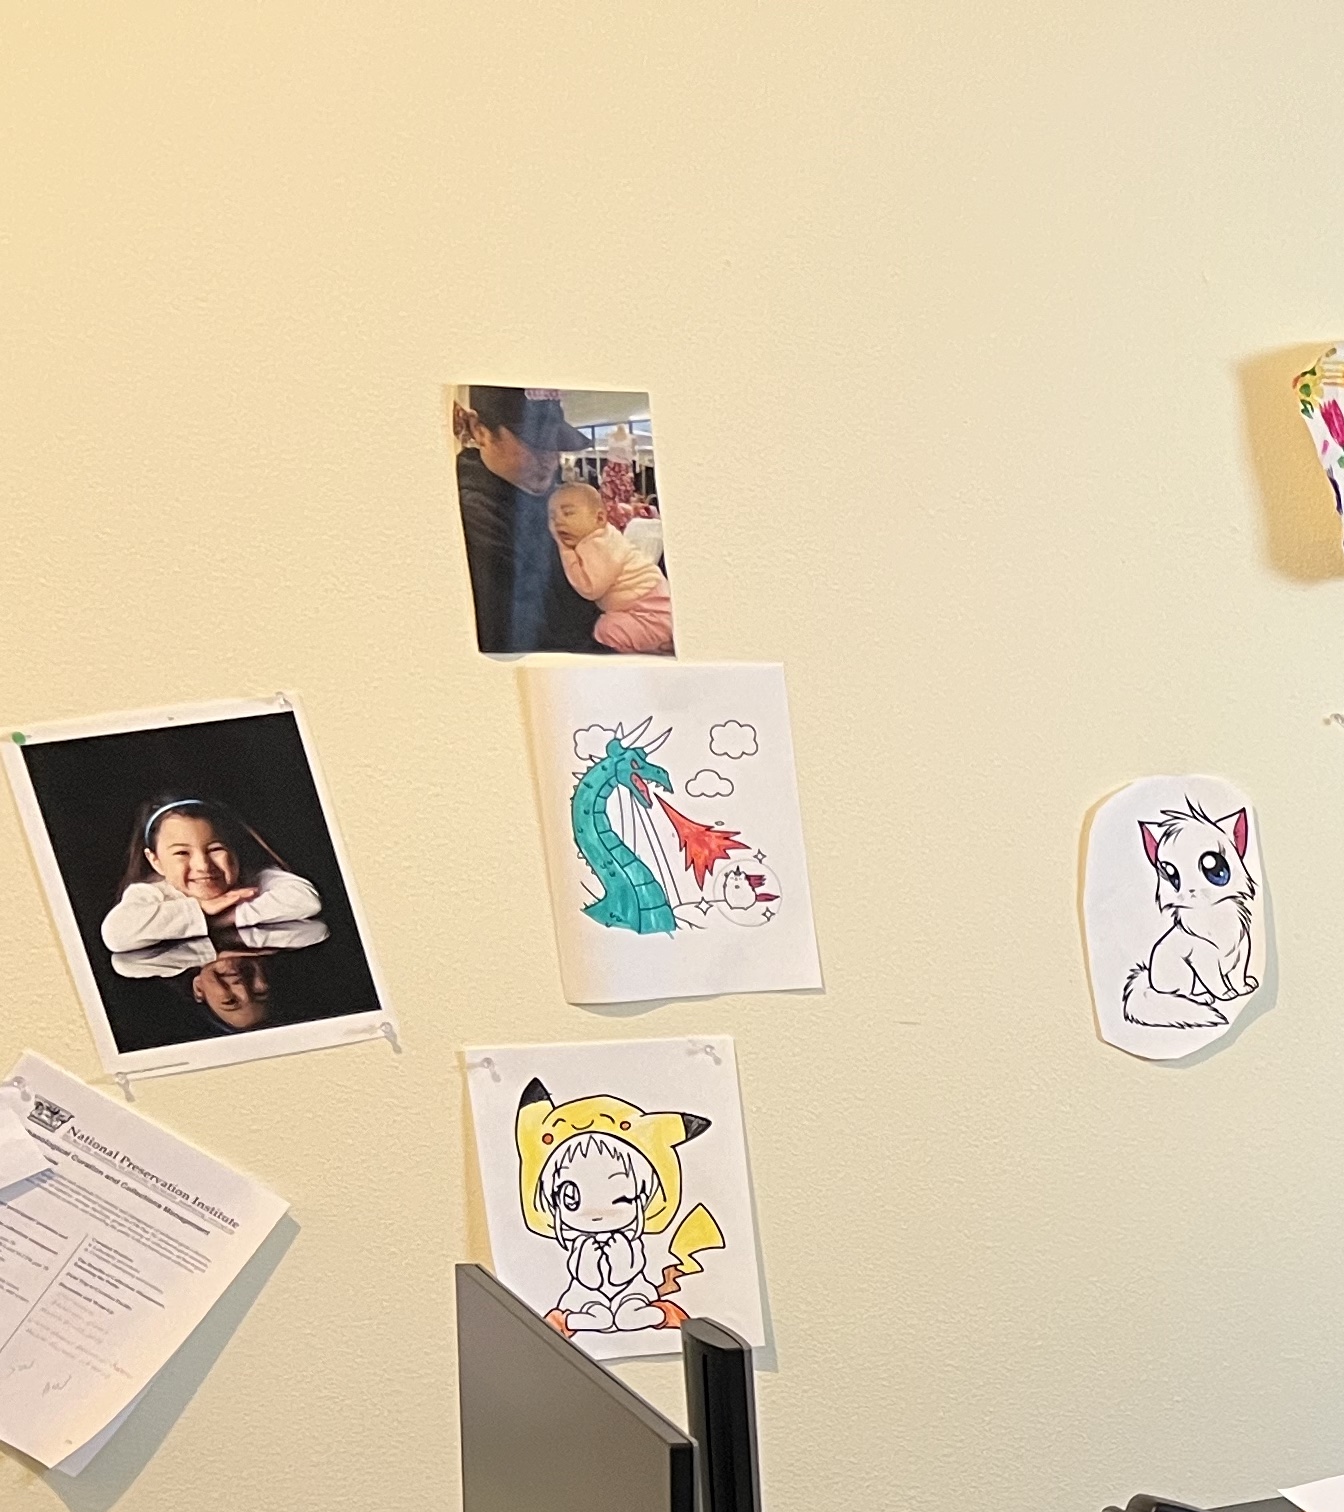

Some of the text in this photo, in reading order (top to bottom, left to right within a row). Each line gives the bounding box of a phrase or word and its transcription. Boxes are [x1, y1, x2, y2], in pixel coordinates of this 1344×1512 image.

[67, 1125, 122, 1161] National
[120, 1154, 191, 1201] Preservation
[192, 1195, 241, 1230] Institute
